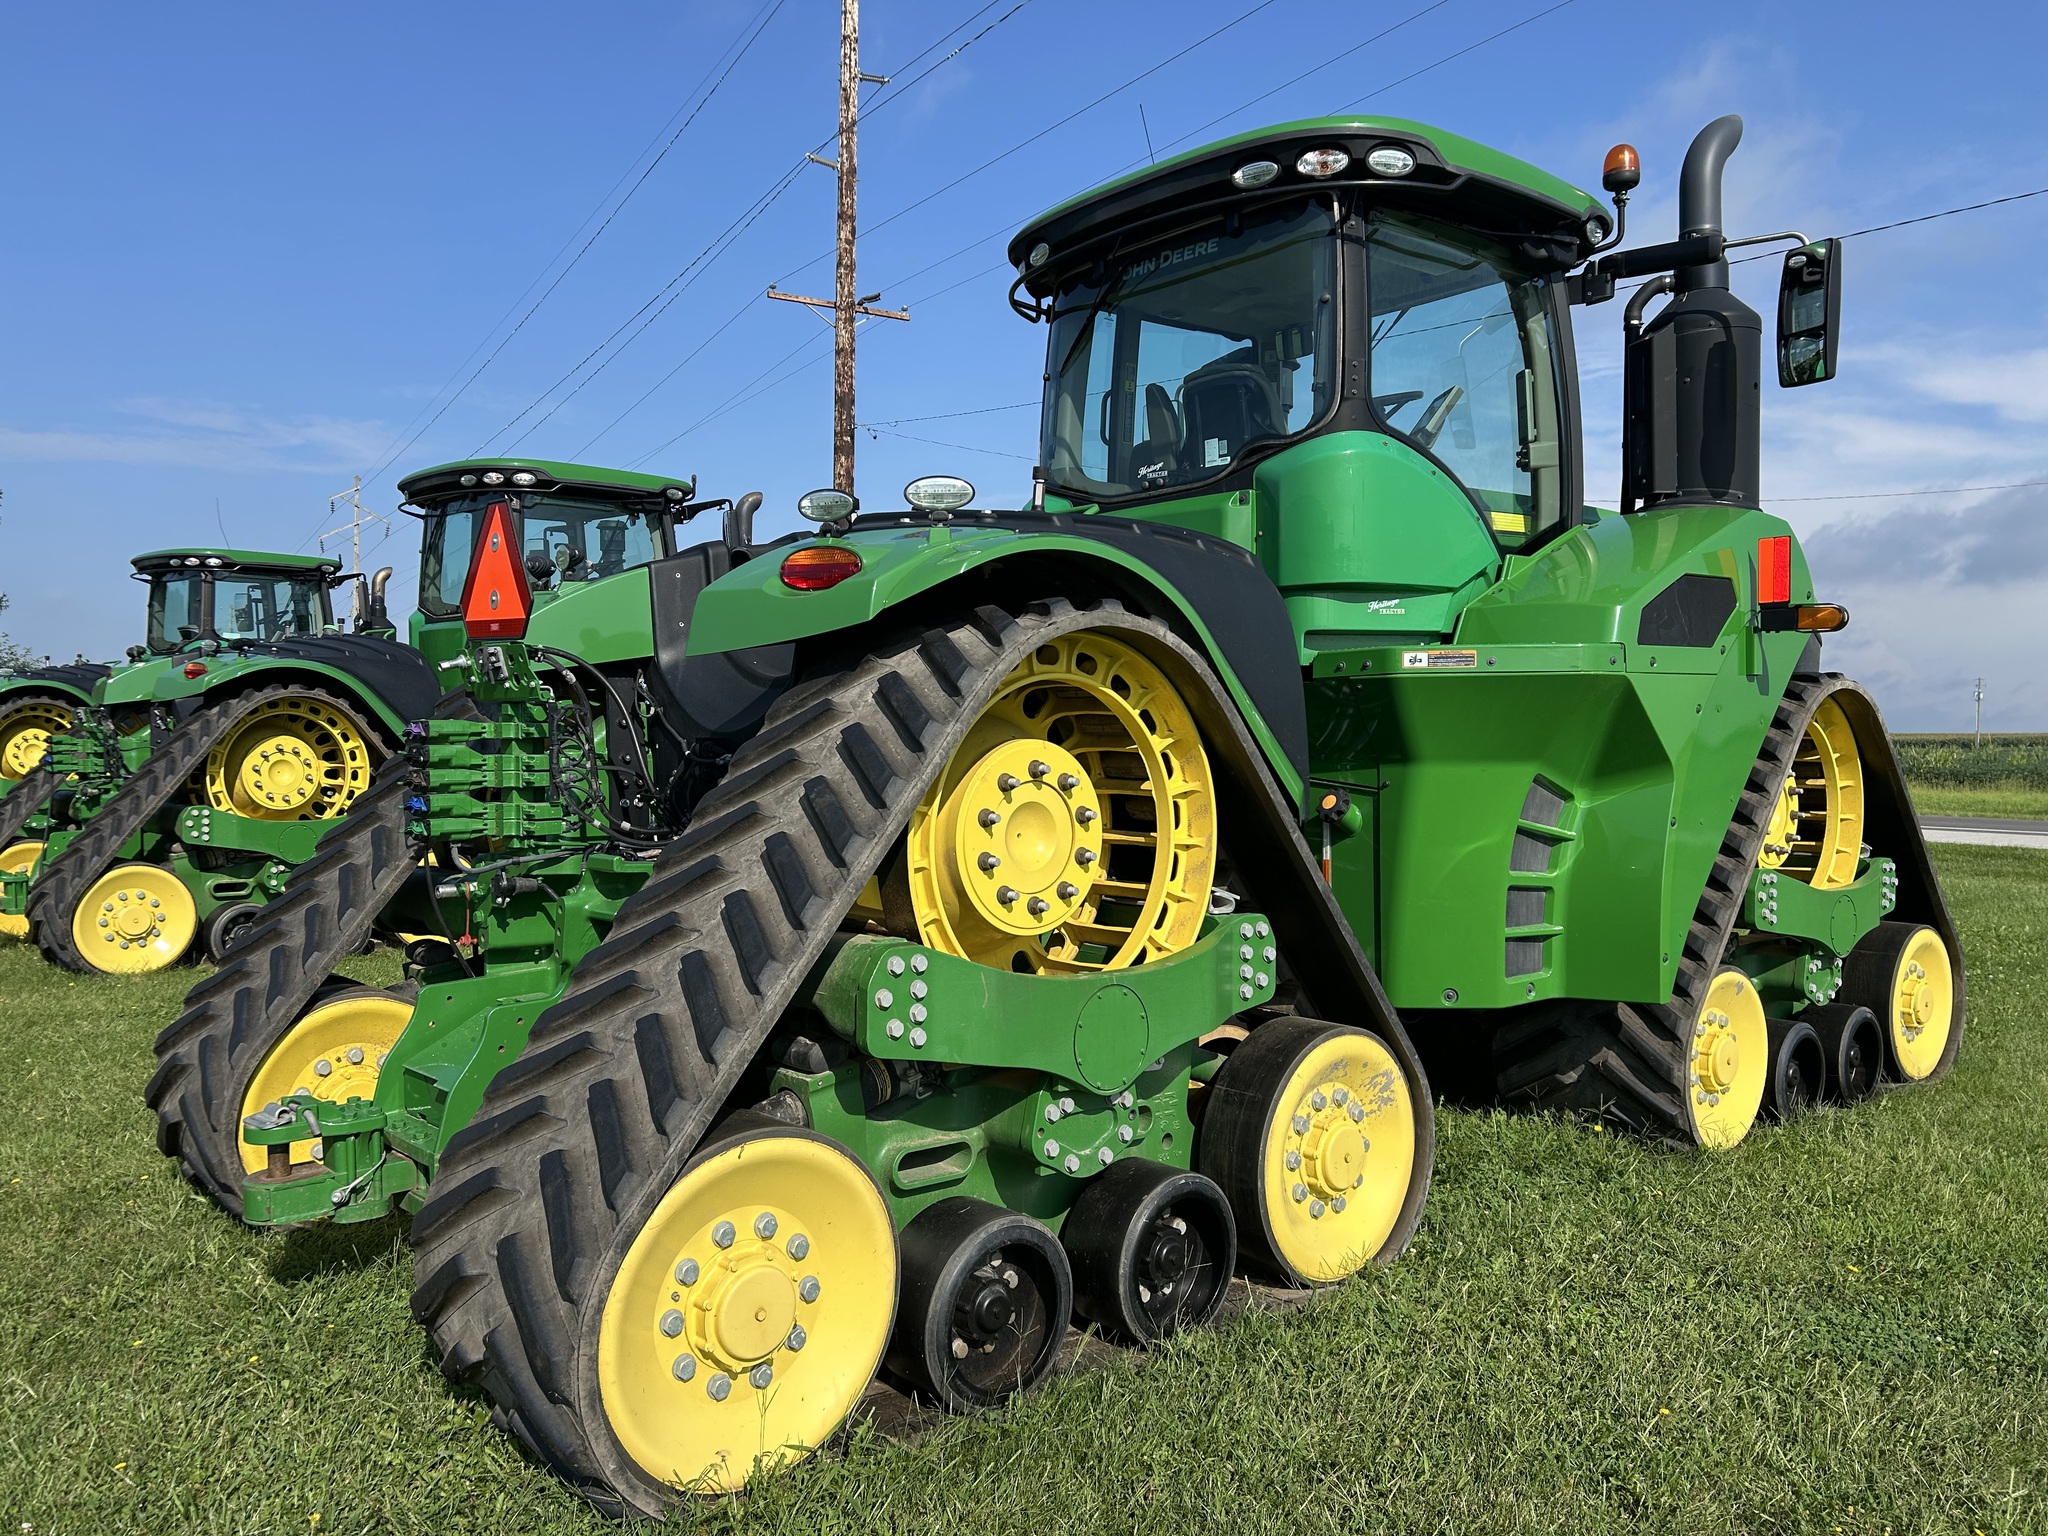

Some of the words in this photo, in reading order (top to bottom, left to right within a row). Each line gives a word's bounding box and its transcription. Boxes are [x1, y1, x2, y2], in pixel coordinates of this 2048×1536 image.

[1121, 257, 1156, 281] OHN
[1160, 237, 1219, 268] DEERE
[1367, 599, 1399, 612] Heritage
